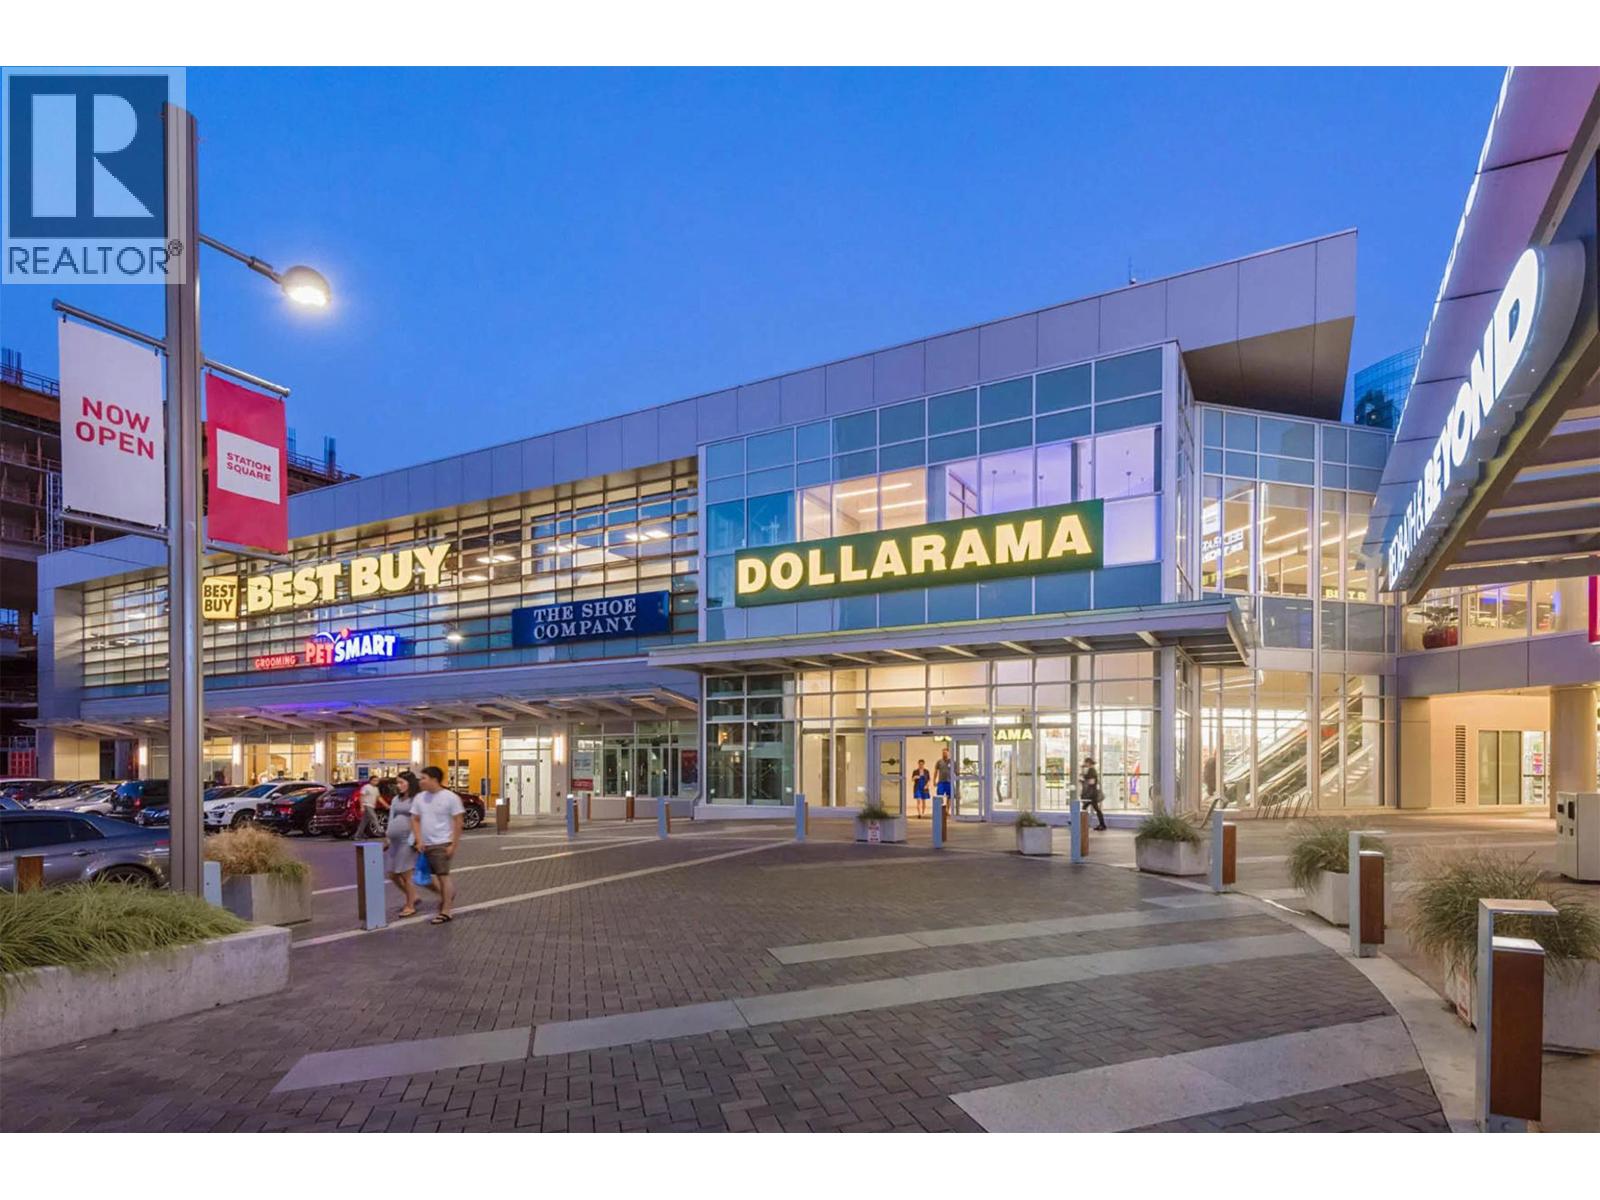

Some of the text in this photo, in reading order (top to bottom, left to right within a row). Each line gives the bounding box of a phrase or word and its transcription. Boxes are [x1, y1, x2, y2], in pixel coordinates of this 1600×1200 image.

[1424, 248, 1539, 527] BEYOND
[82, 397, 150, 433] NOW
[75, 421, 154, 460] OPEN
[226, 452, 272, 473] STATION
[226, 461, 272, 482] SQUARE
[738, 514, 1093, 594] DOLLARAMA
[247, 543, 452, 612] BEST BUY
[203, 583, 236, 598] BEST
[204, 599, 233, 612] BUY
[533, 598, 637, 623] THE SHOE
[533, 615, 637, 640] COMPANY
[255, 655, 296, 669] GROOMING
